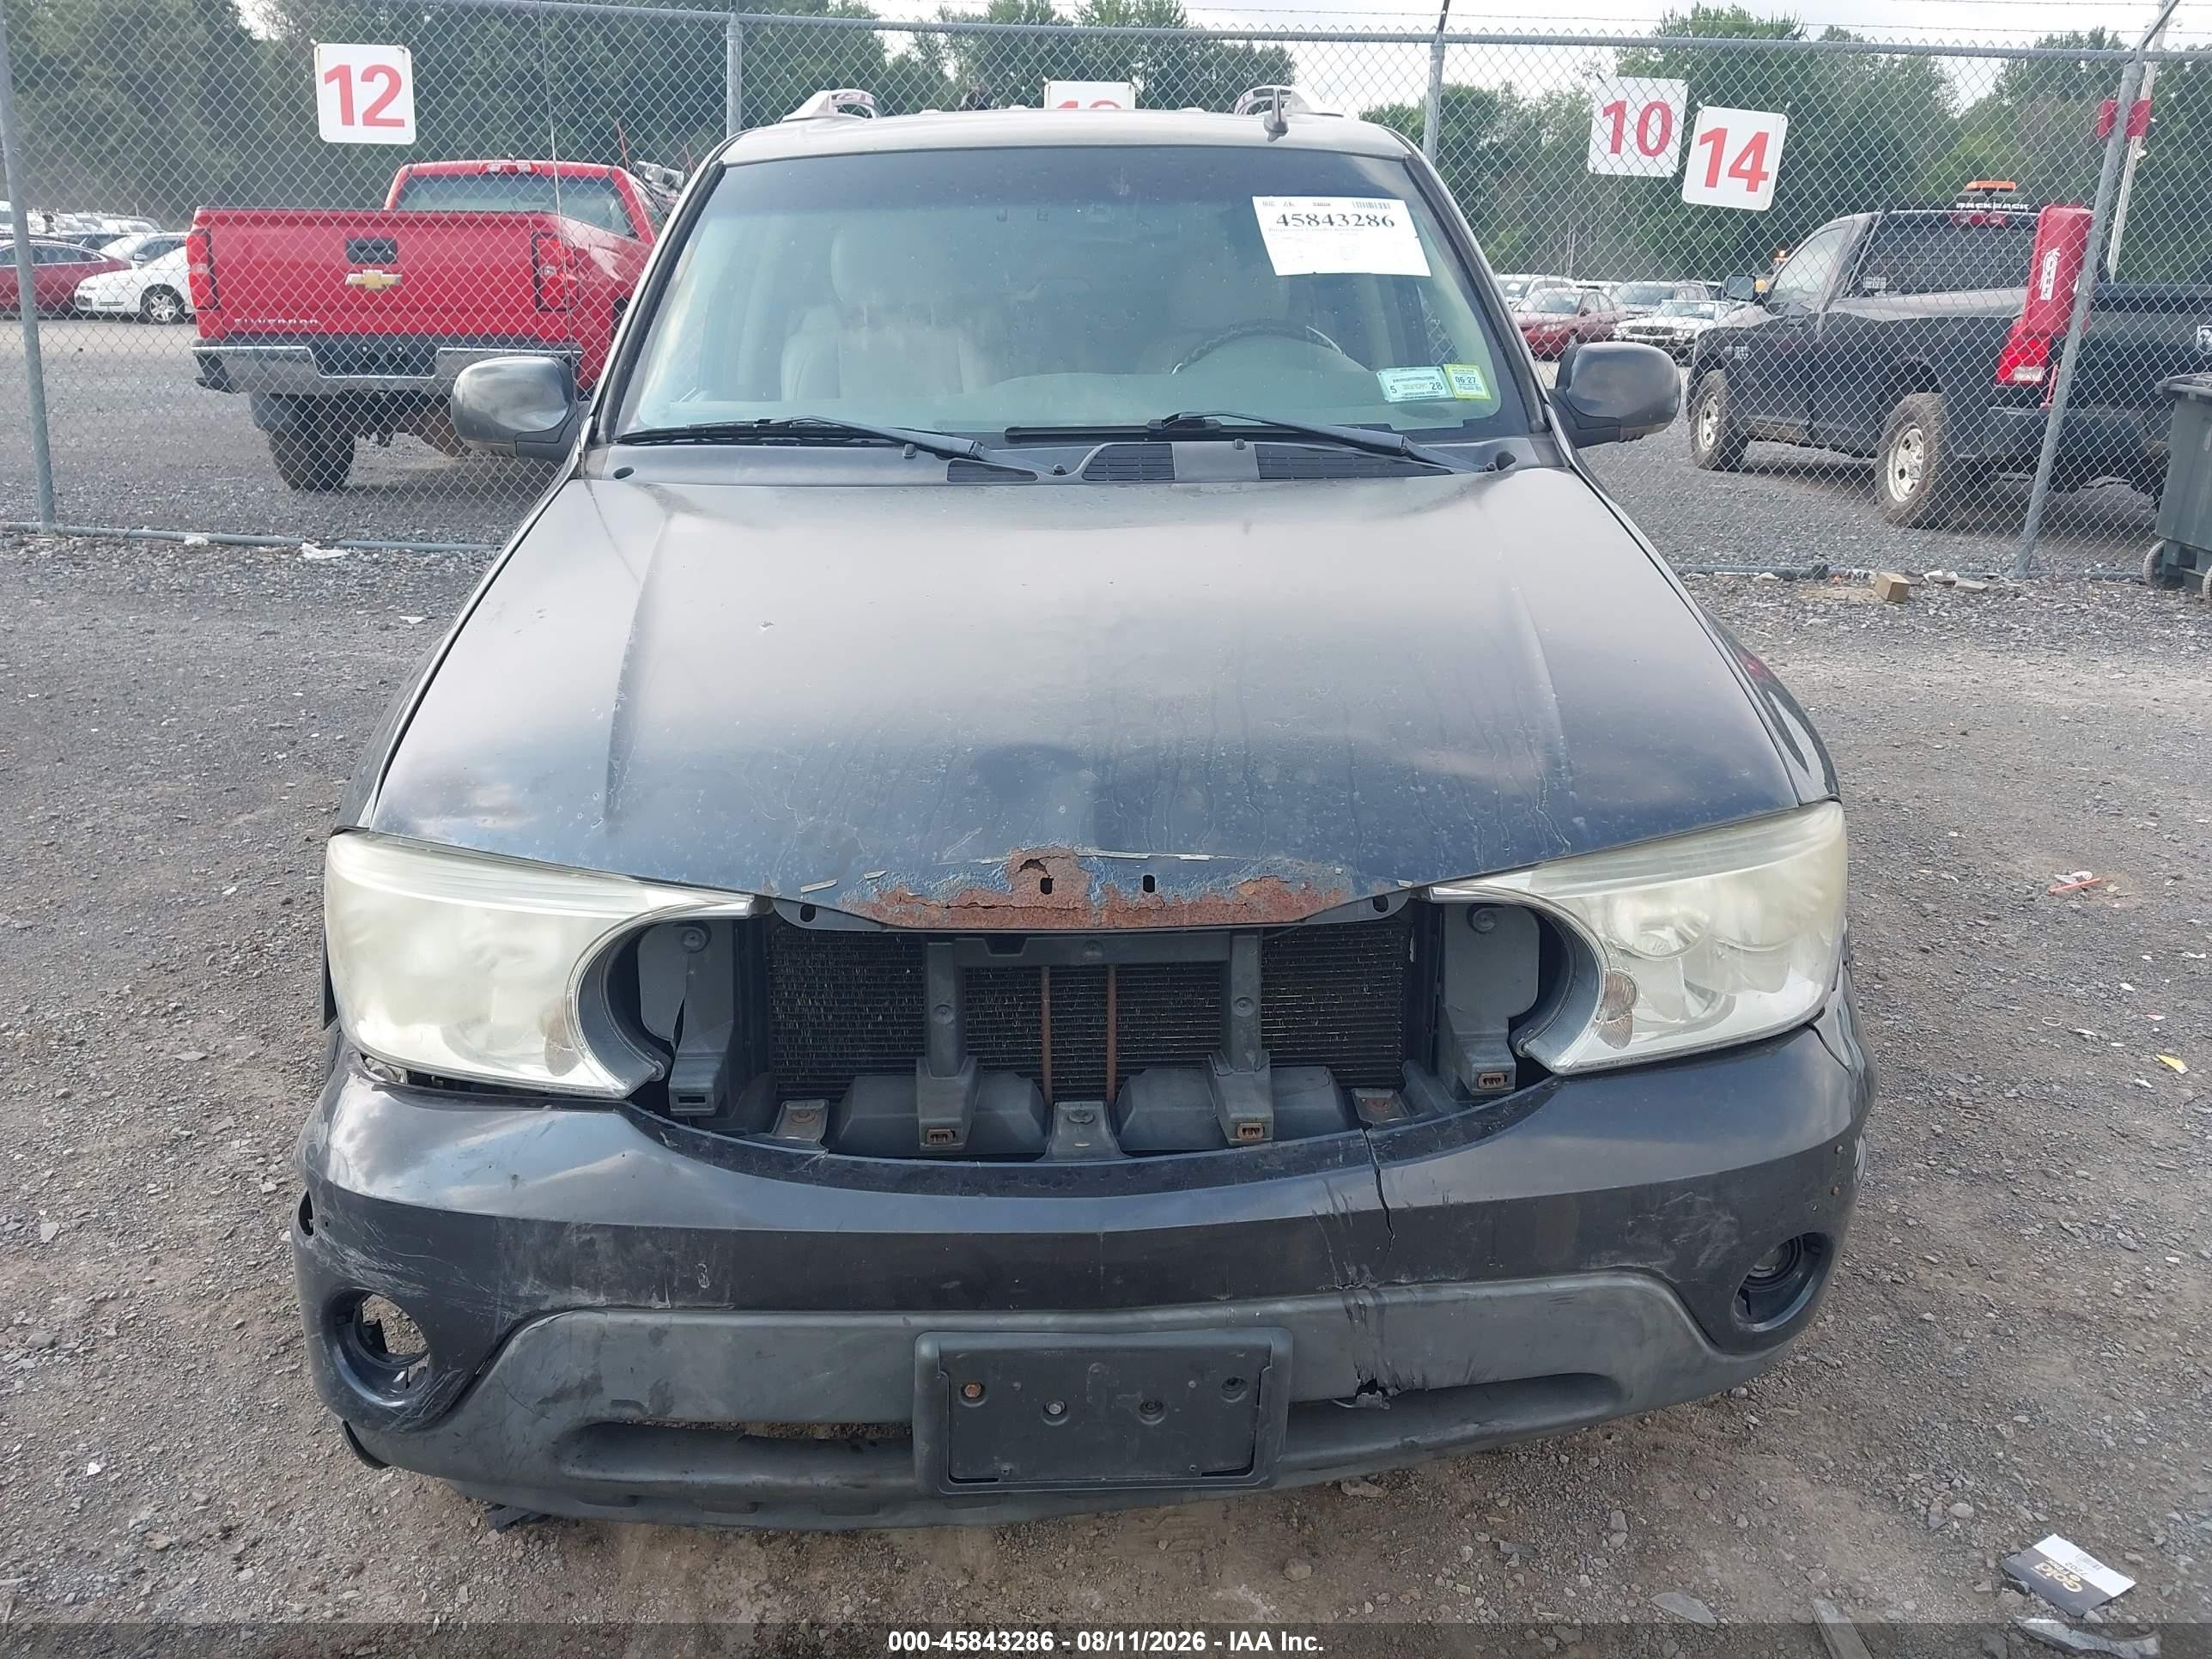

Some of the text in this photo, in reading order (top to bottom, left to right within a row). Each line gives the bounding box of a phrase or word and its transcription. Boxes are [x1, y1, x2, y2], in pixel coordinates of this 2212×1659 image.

[324, 64, 405, 128] 12
[1602, 100, 1674, 157] 10
[1698, 127, 1770, 193] 14
[1276, 213, 1395, 228] 45843286
[1429, 381, 1443, 391] 28
[2033, 1561, 2083, 1593] Gold
